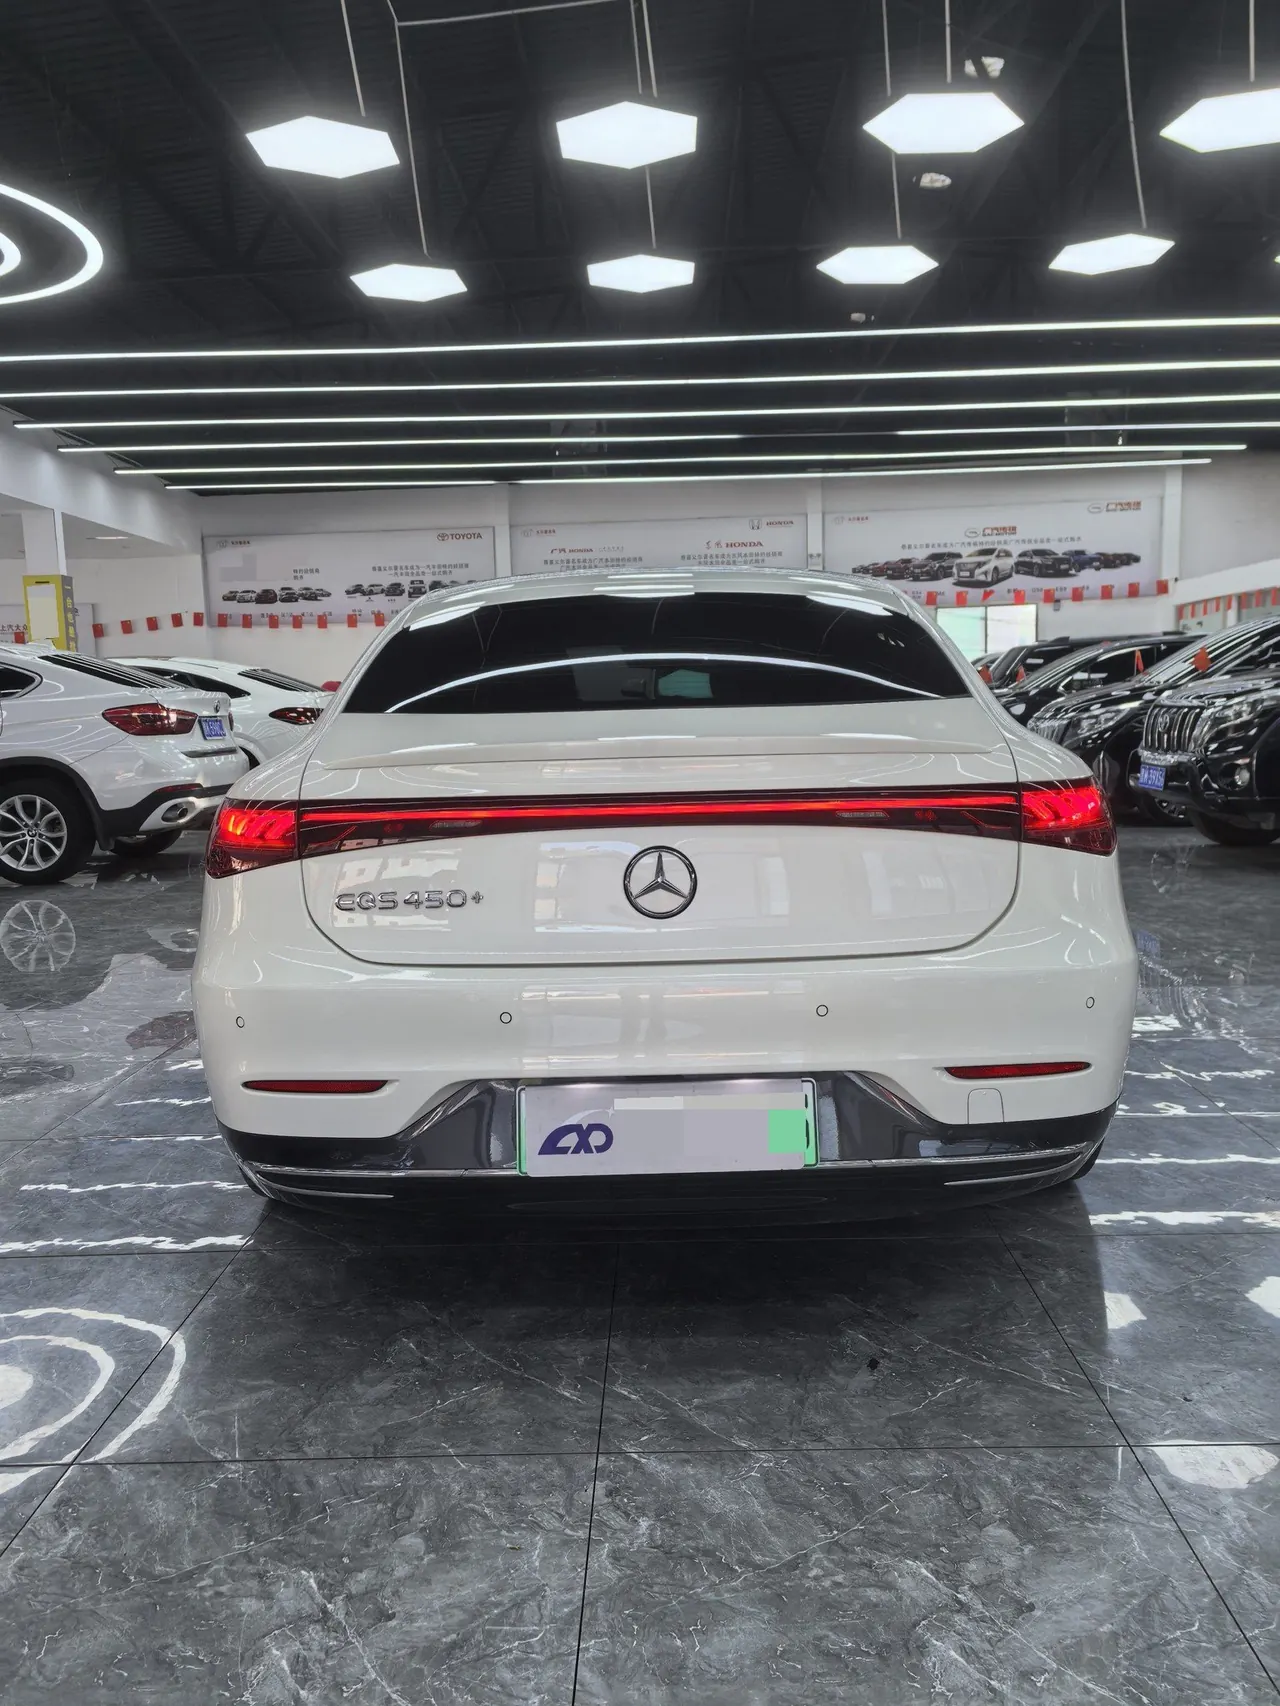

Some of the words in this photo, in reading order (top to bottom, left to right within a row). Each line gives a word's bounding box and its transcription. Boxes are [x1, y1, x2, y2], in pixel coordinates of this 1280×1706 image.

[450, 532, 483, 541] TOYOTA
[725, 541, 764, 549] HONDA
[0, 624, 29, 632] 上汽大众
[334, 891, 399, 912] EQS
[403, 889, 484, 909] 450+
